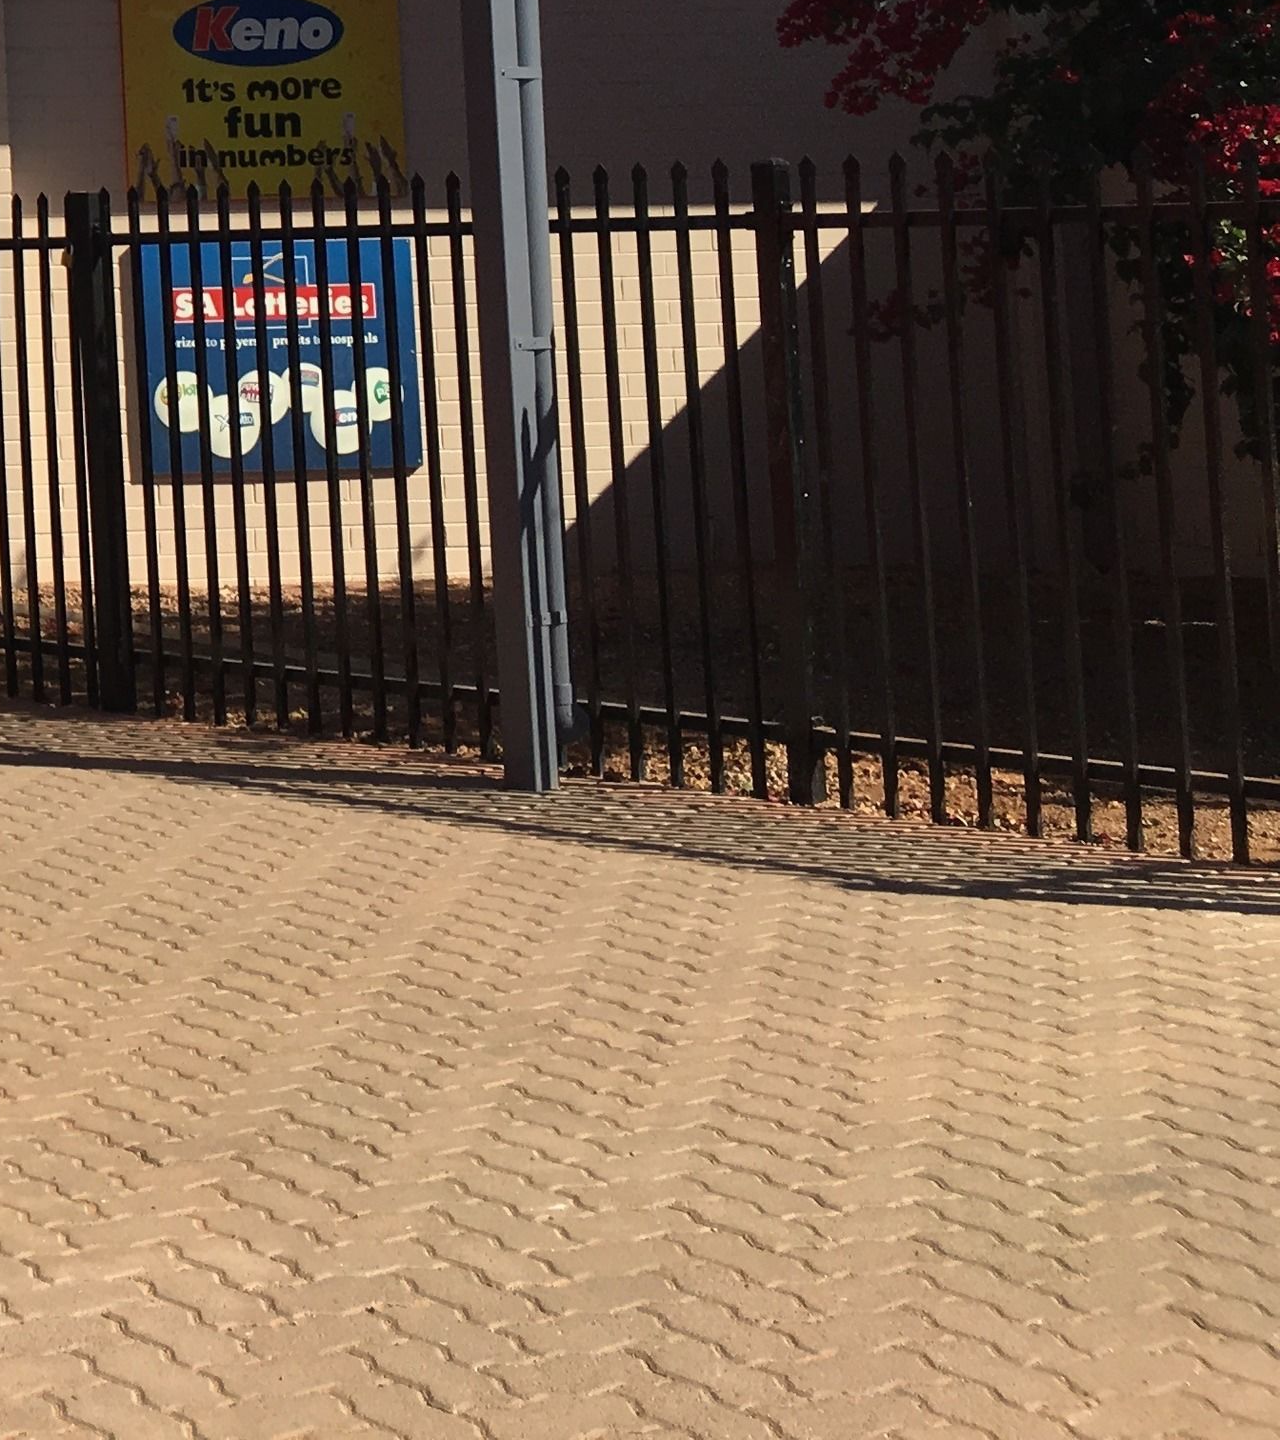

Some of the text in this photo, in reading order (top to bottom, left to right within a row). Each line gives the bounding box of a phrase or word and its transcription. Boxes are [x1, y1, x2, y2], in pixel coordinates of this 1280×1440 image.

[192, 6, 334, 52] Keno
[247, 77, 342, 101] more
[224, 106, 302, 139] fun
[179, 144, 354, 168] in numbers
[175, 292, 219, 319] SA
[206, 337, 217, 348] to
